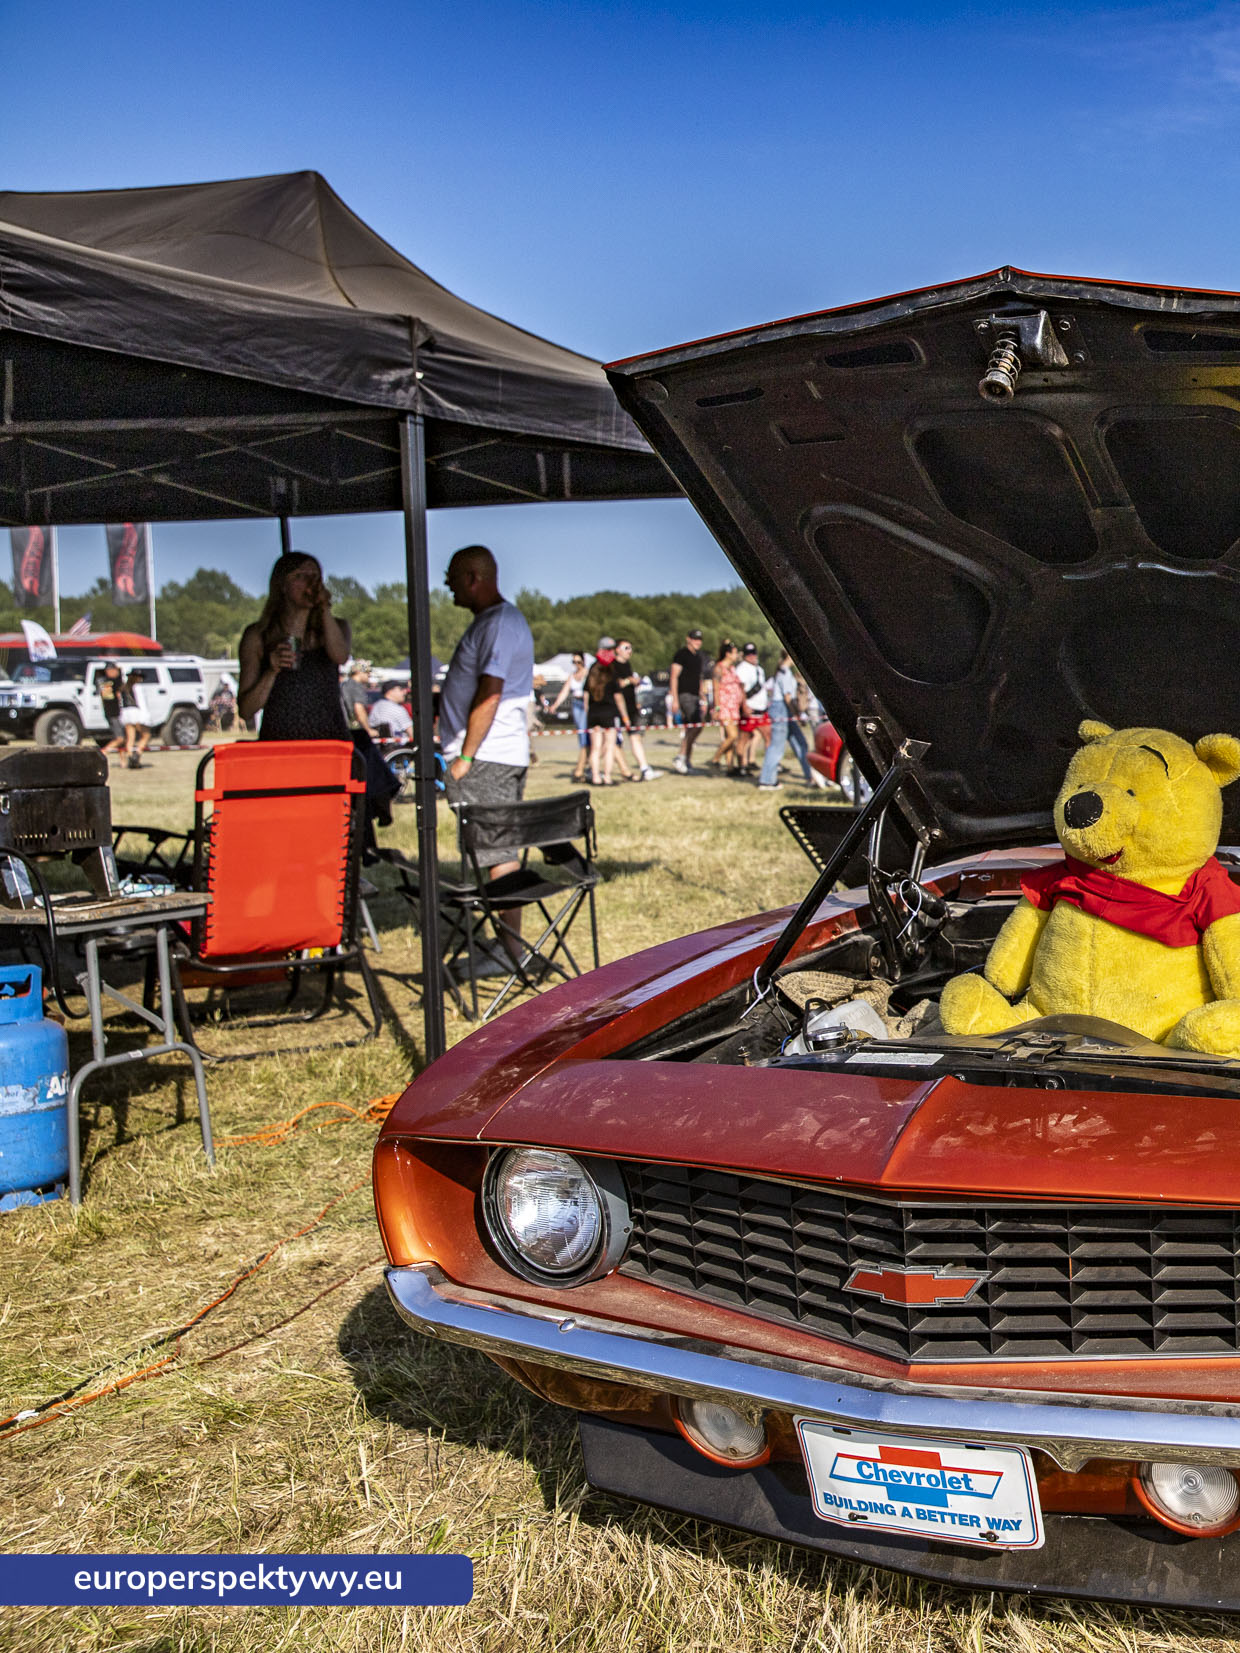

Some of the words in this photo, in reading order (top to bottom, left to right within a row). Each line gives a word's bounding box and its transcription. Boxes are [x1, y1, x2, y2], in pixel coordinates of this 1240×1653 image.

[856, 1460, 974, 1492] Chevrolet
[823, 1492, 897, 1517] BUILDING
[901, 1505, 916, 1519] A
[915, 1508, 981, 1529] BETTER
[985, 1516, 1022, 1532] WAY
